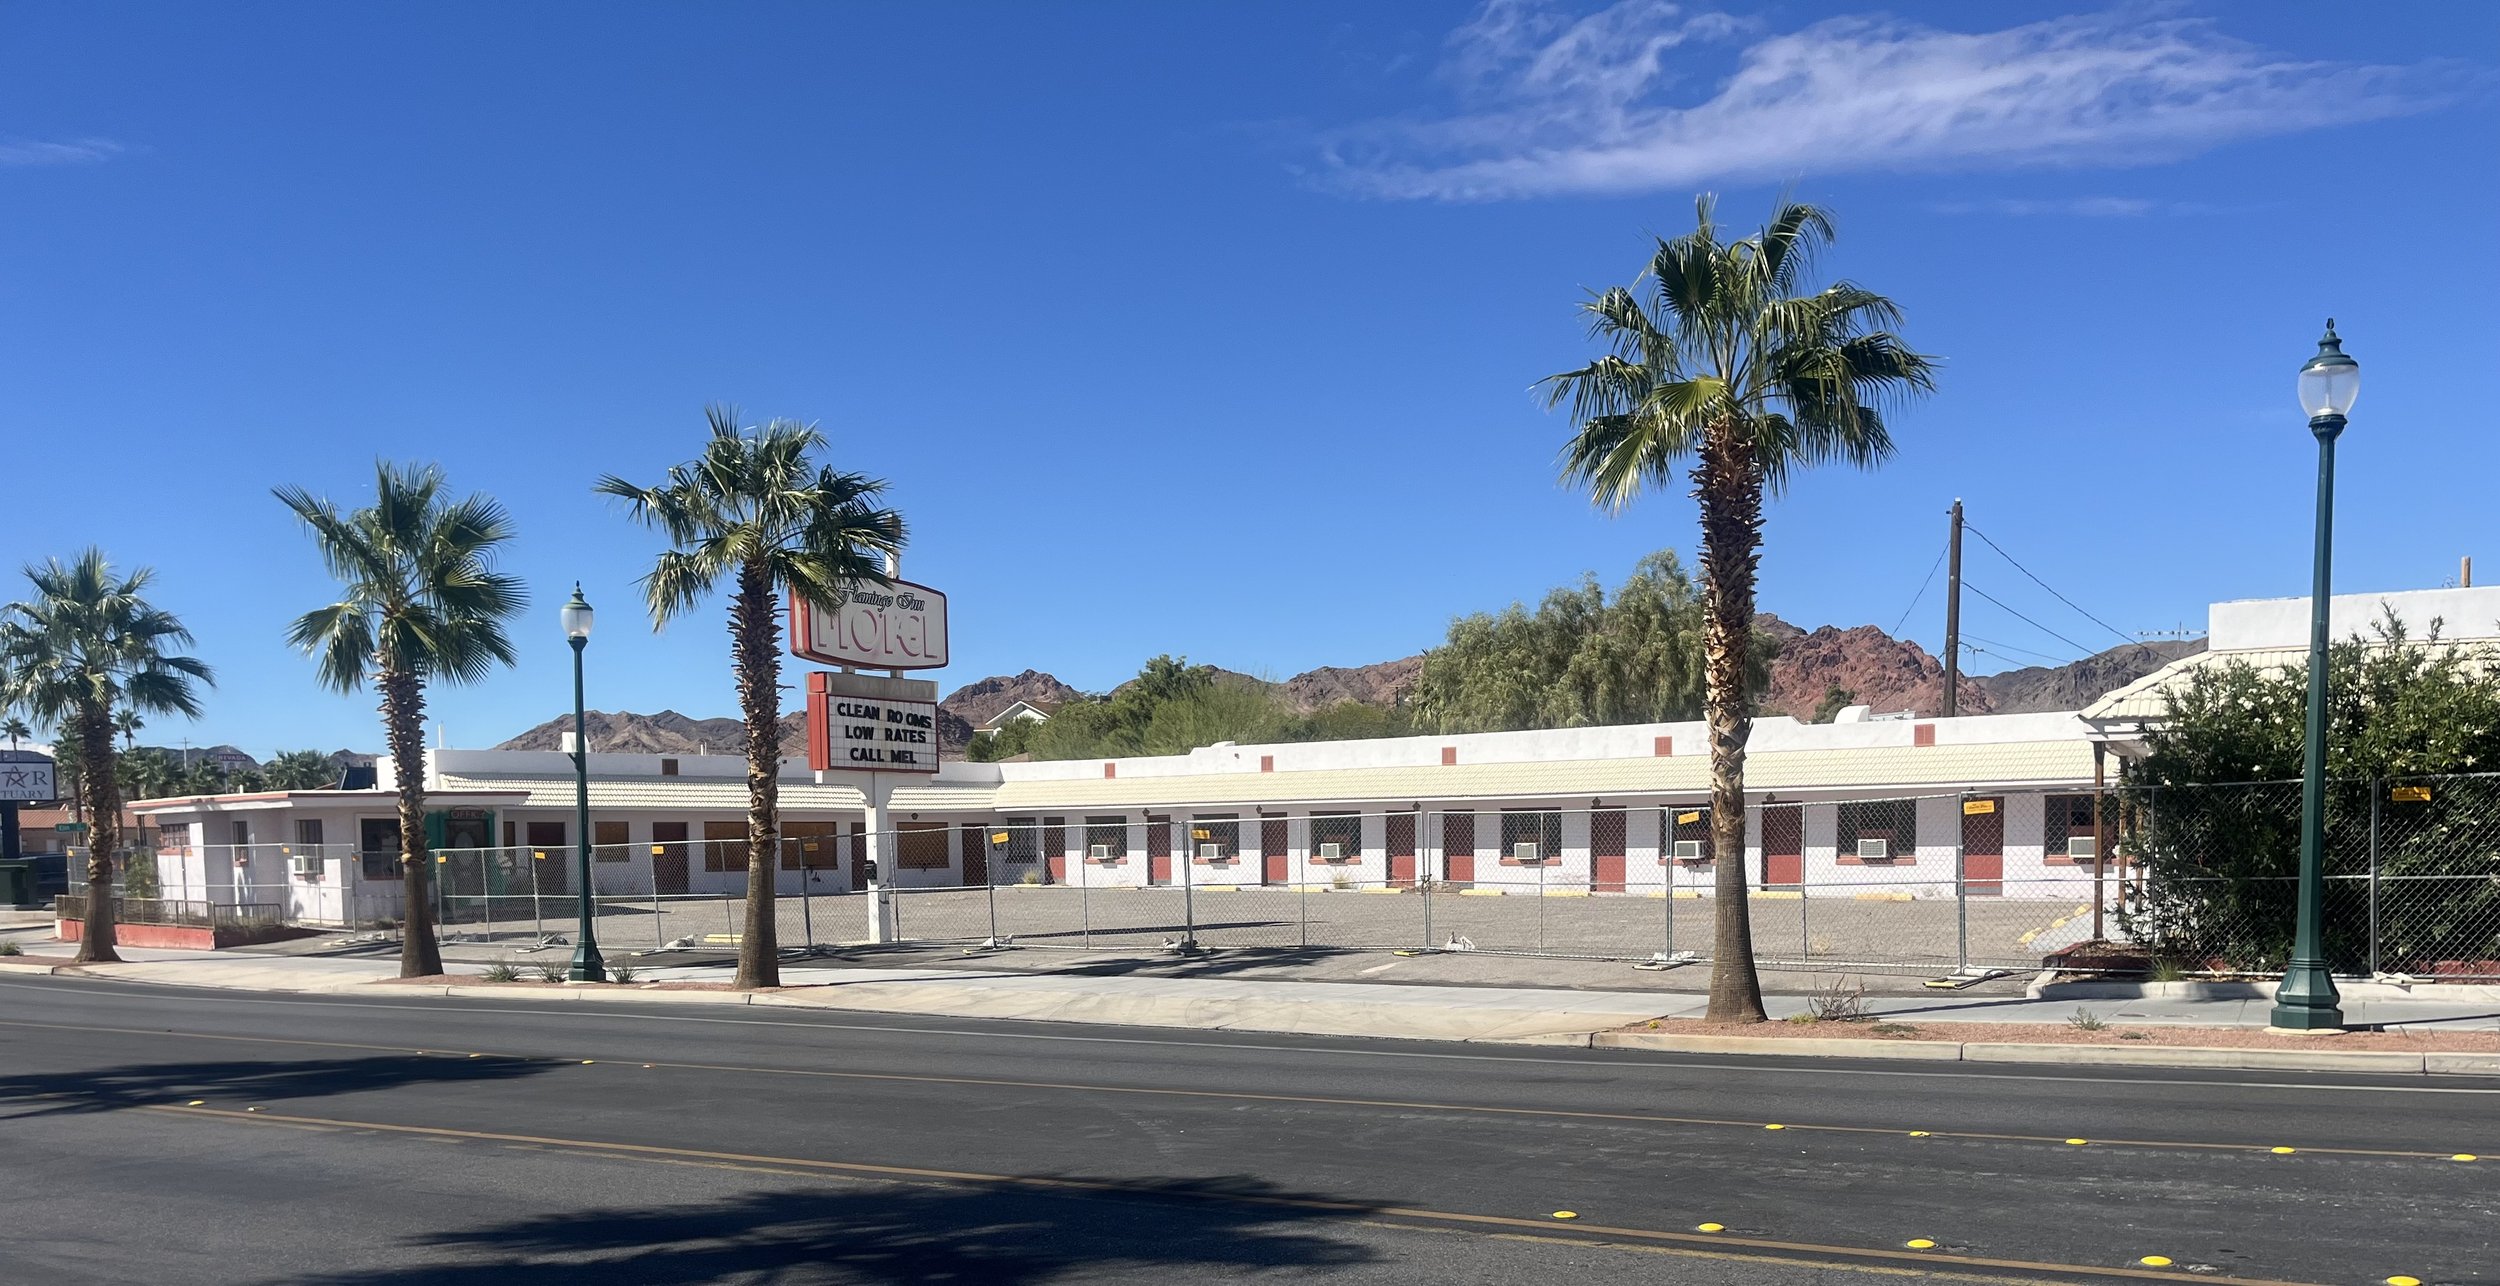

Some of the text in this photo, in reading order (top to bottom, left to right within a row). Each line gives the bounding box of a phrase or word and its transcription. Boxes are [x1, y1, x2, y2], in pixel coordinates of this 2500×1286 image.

[896, 592, 925, 611] Inn
[837, 702, 880, 720] CLEAN
[845, 725, 926, 743] LOW RATES
[850, 748, 917, 764] CALL MEL
